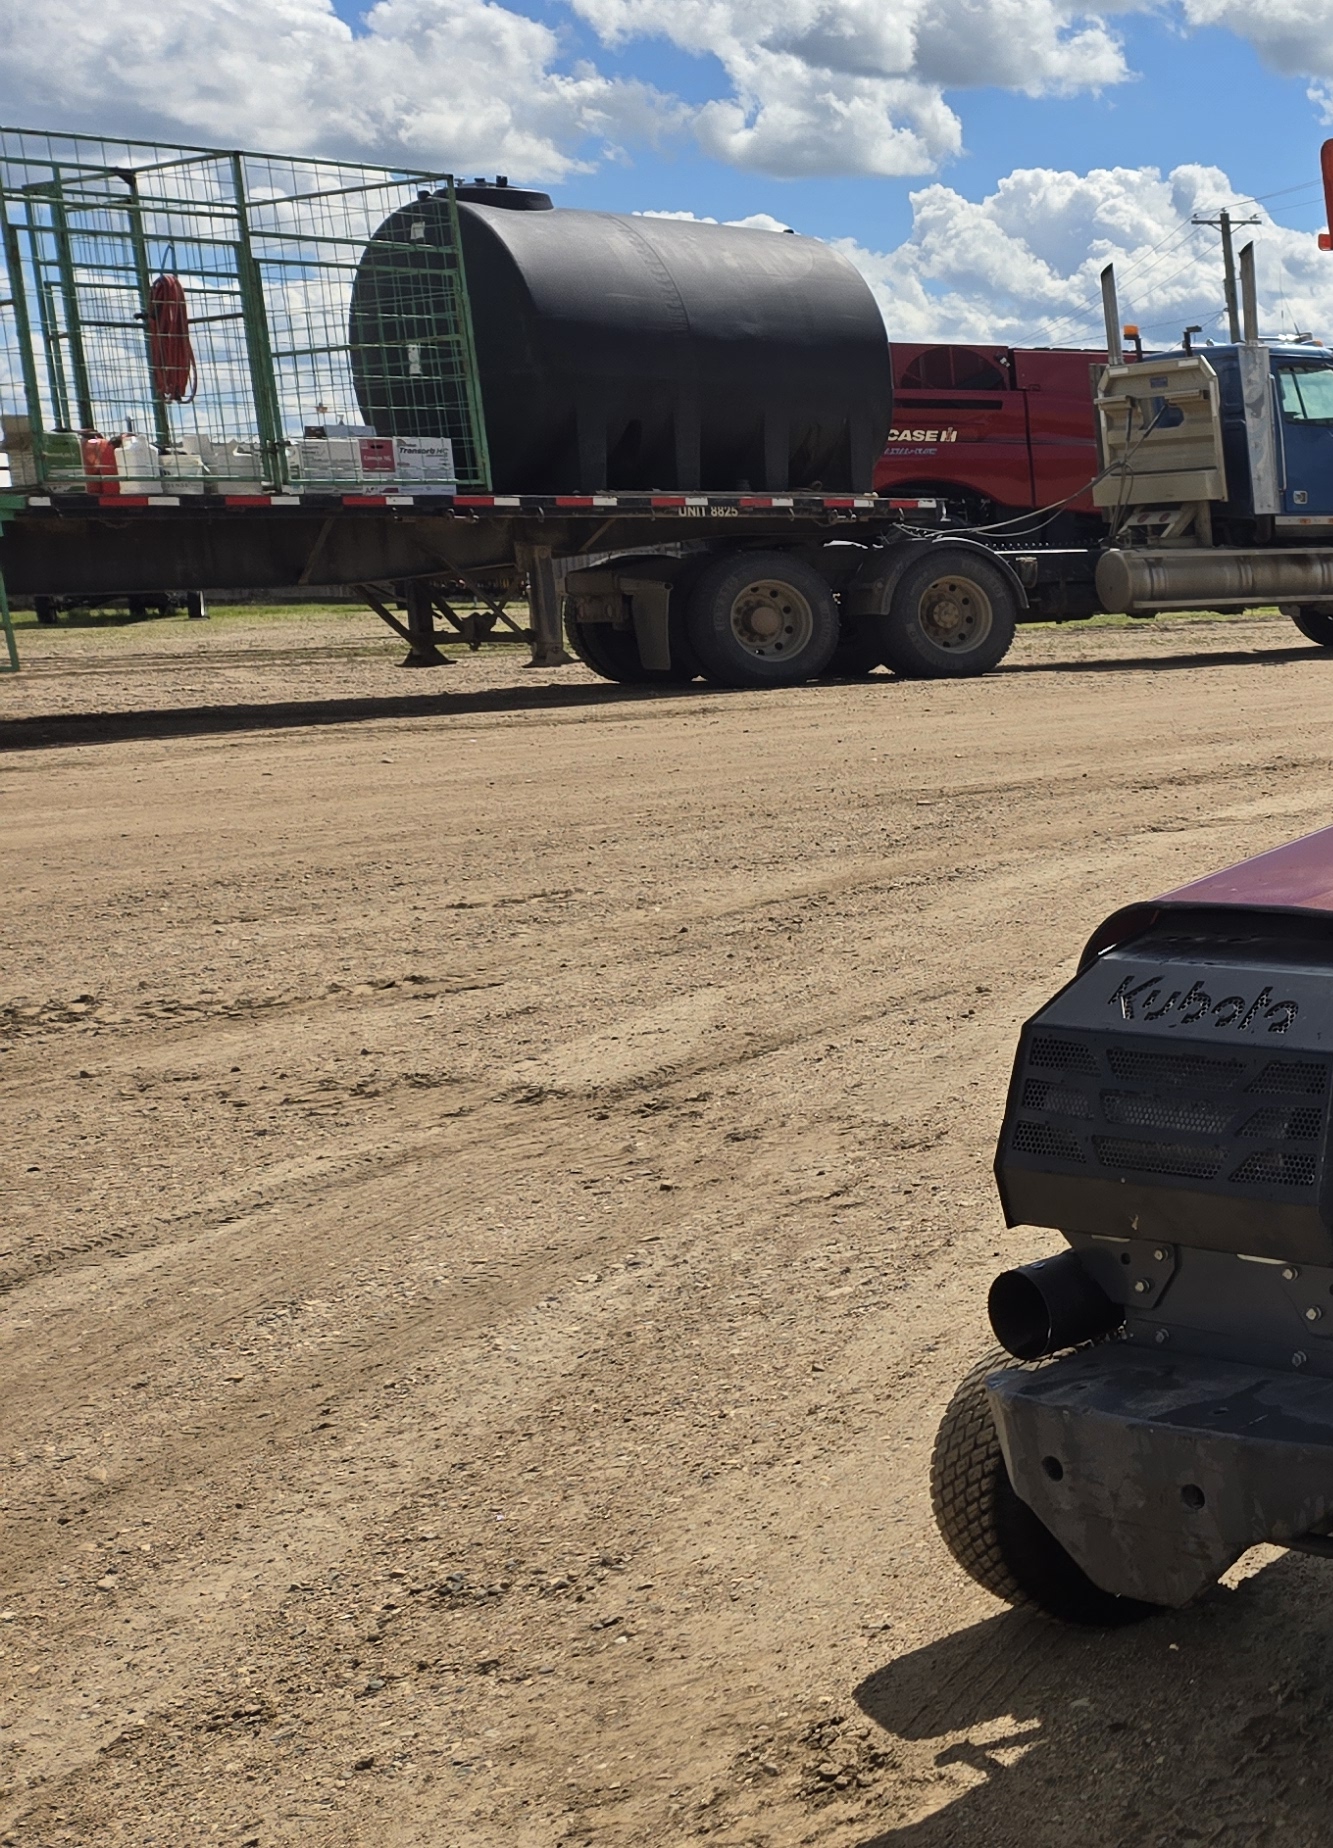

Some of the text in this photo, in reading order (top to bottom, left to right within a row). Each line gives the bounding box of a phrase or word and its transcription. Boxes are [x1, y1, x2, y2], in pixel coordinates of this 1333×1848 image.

[888, 429, 939, 441] CASE
[400, 447, 435, 455] Transorb
[679, 506, 738, 517] UNIT 8825
[1107, 975, 1299, 1035] Kubota
